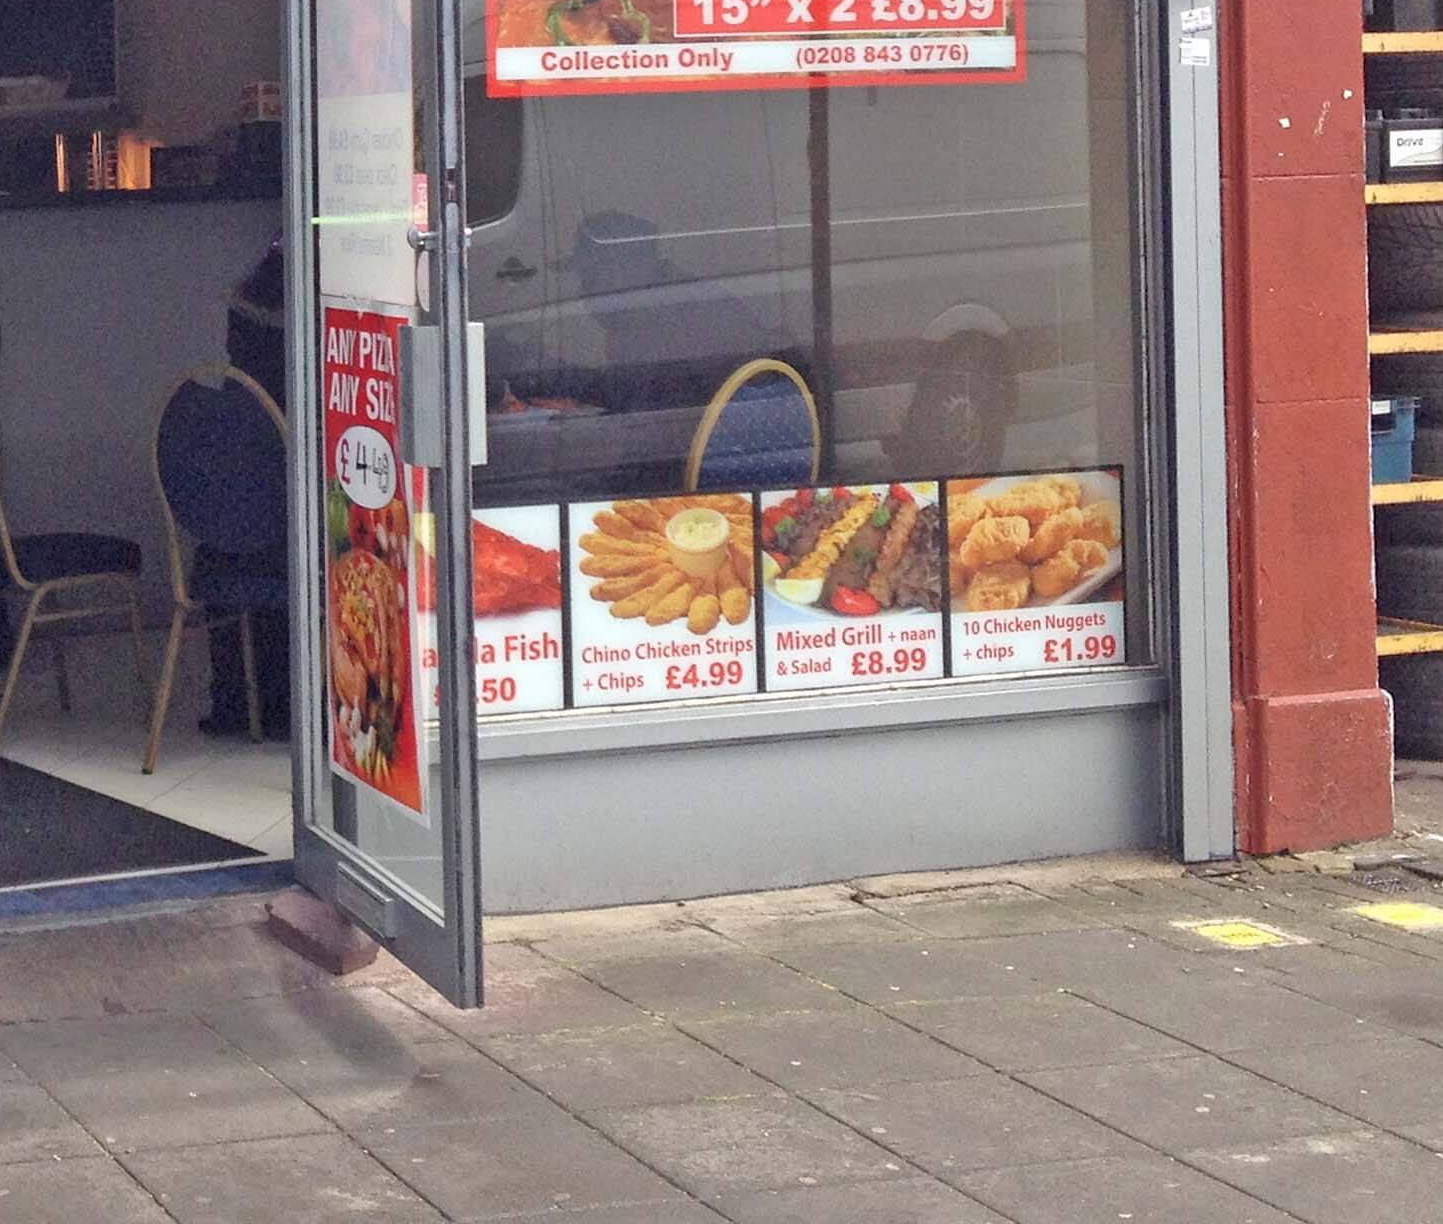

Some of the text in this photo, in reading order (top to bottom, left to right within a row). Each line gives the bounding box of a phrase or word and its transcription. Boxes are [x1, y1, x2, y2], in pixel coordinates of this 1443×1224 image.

[541, 44, 969, 73] Collection Only (0208 843 0776)
[327, 327, 357, 366] ANY
[329, 372, 360, 416] ANY
[776, 627, 836, 651] Mixed
[842, 624, 881, 646] Grill
[900, 629, 936, 642] naan
[963, 613, 1106, 636] 10 Chicken Nuggets
[504, 632, 559, 662] Fish
[582, 636, 754, 664] Chino Chicken Strips
[976, 644, 1015, 662] chips
[1044, 635, 1117, 663] £1.99
[666, 660, 743, 690] £4.99
[777, 657, 832, 676] & Salad
[852, 648, 926, 676] £8.99
[598, 672, 644, 692] Chips
